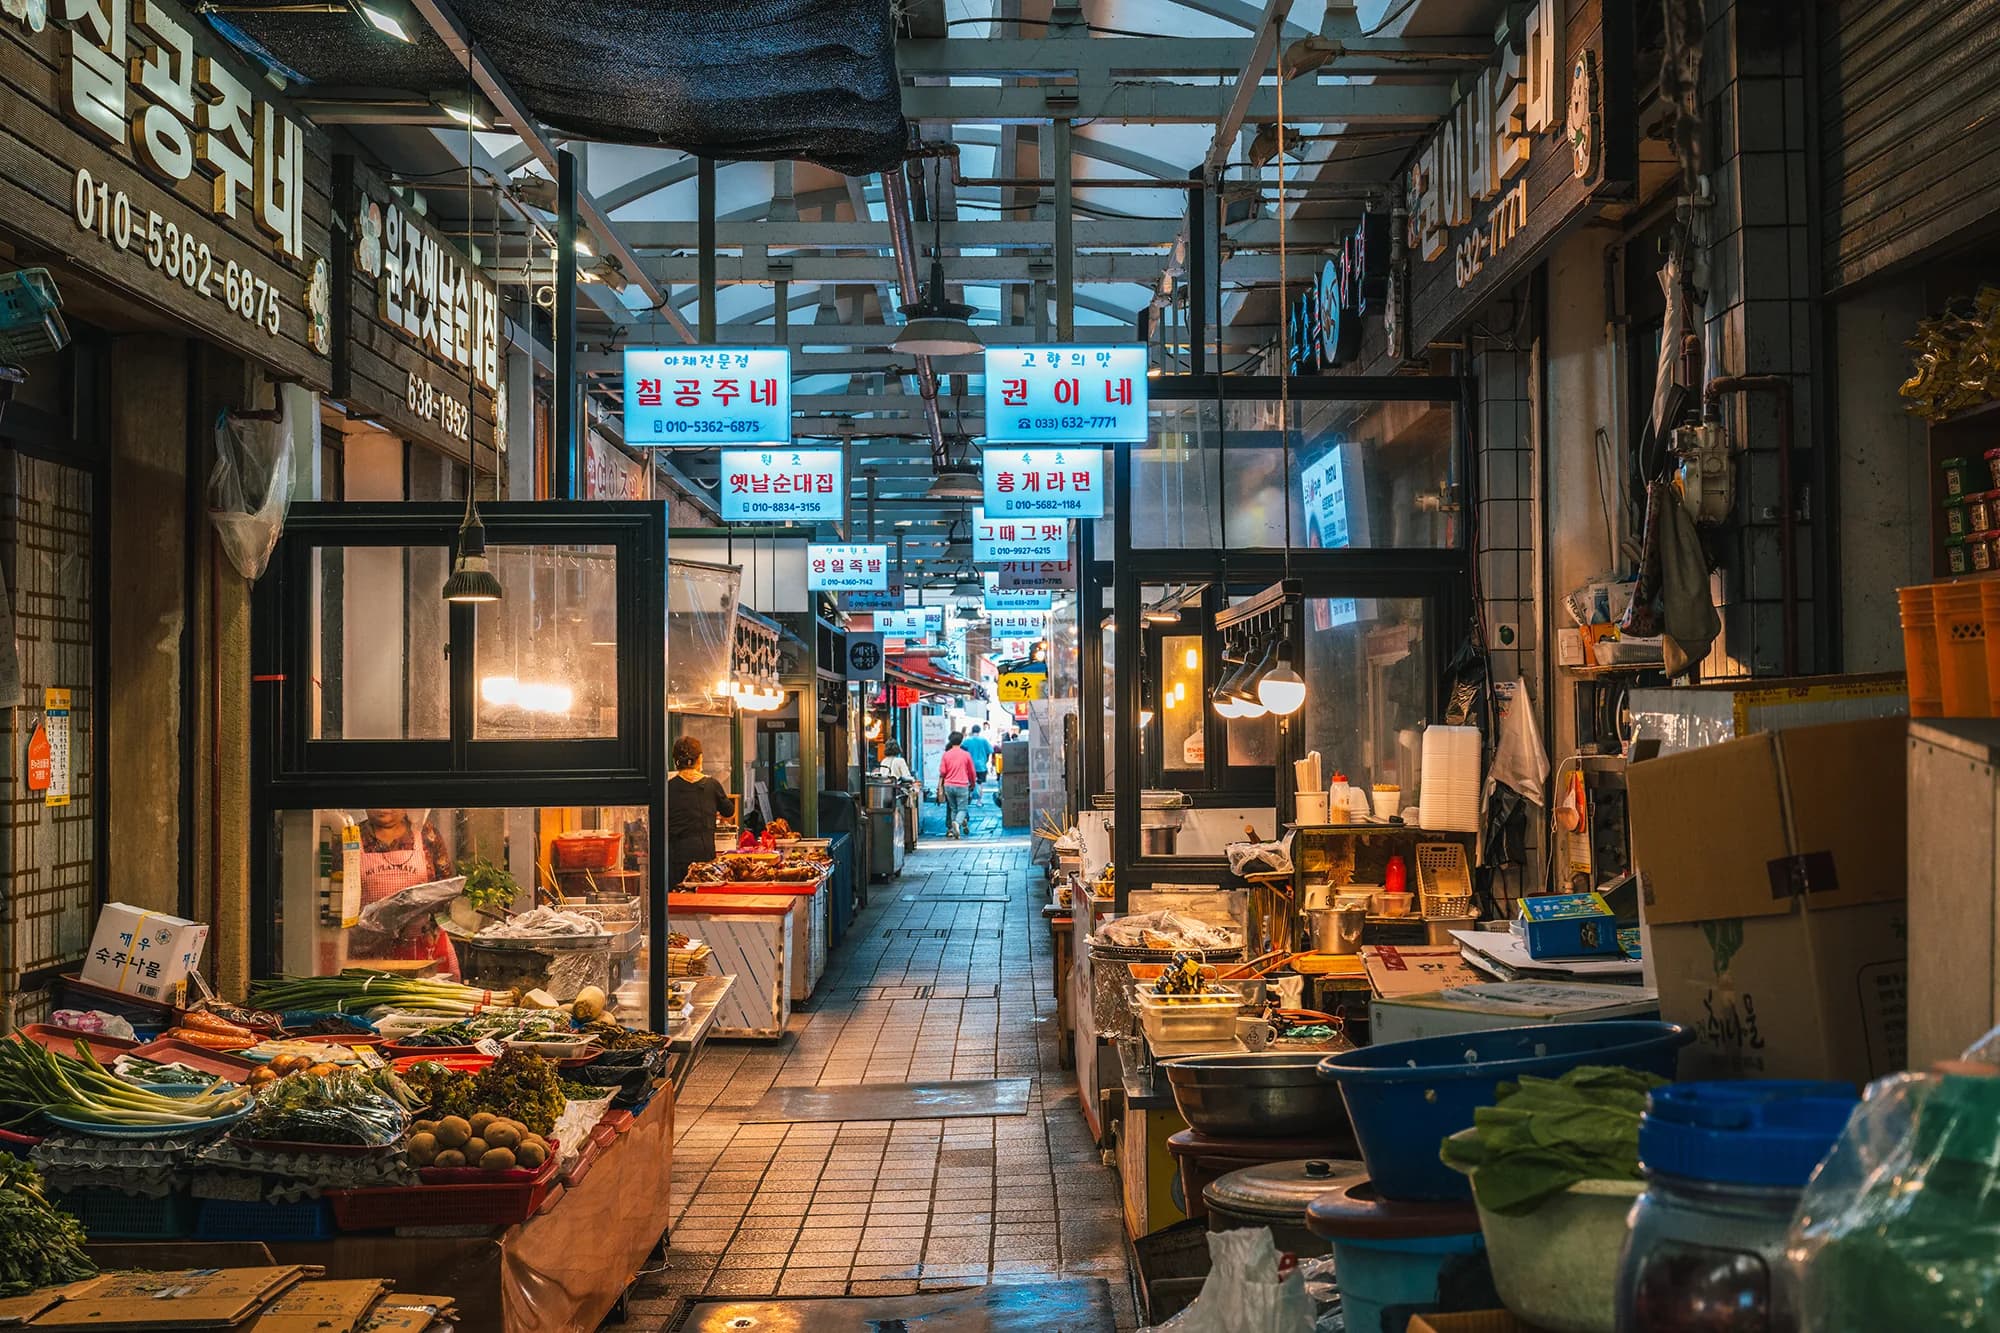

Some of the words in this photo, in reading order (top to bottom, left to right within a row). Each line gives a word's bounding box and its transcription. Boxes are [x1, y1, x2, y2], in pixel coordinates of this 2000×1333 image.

[1455, 178, 1527, 289] 632-7771
[75, 168, 281, 336] 010-5362-6875
[636, 378, 777, 407] 칠공주네
[1001, 378, 1132, 406] 권이네
[407, 372, 468, 441] 638-1352
[666, 420, 760, 433] 010-5362-6875
[1062, 416, 1117, 428] 632-7771
[730, 473, 833, 493] 옛날순대집
[997, 471, 1092, 492] 홍게라면
[752, 502, 820, 512] 010-8834-3156
[1016, 500, 1081, 510] 010-5682-1184
[997, 547, 1051, 555] 010-9927-6215
[813, 559, 882, 573] 영일족발
[95, 947, 161, 978] 숙주나물
